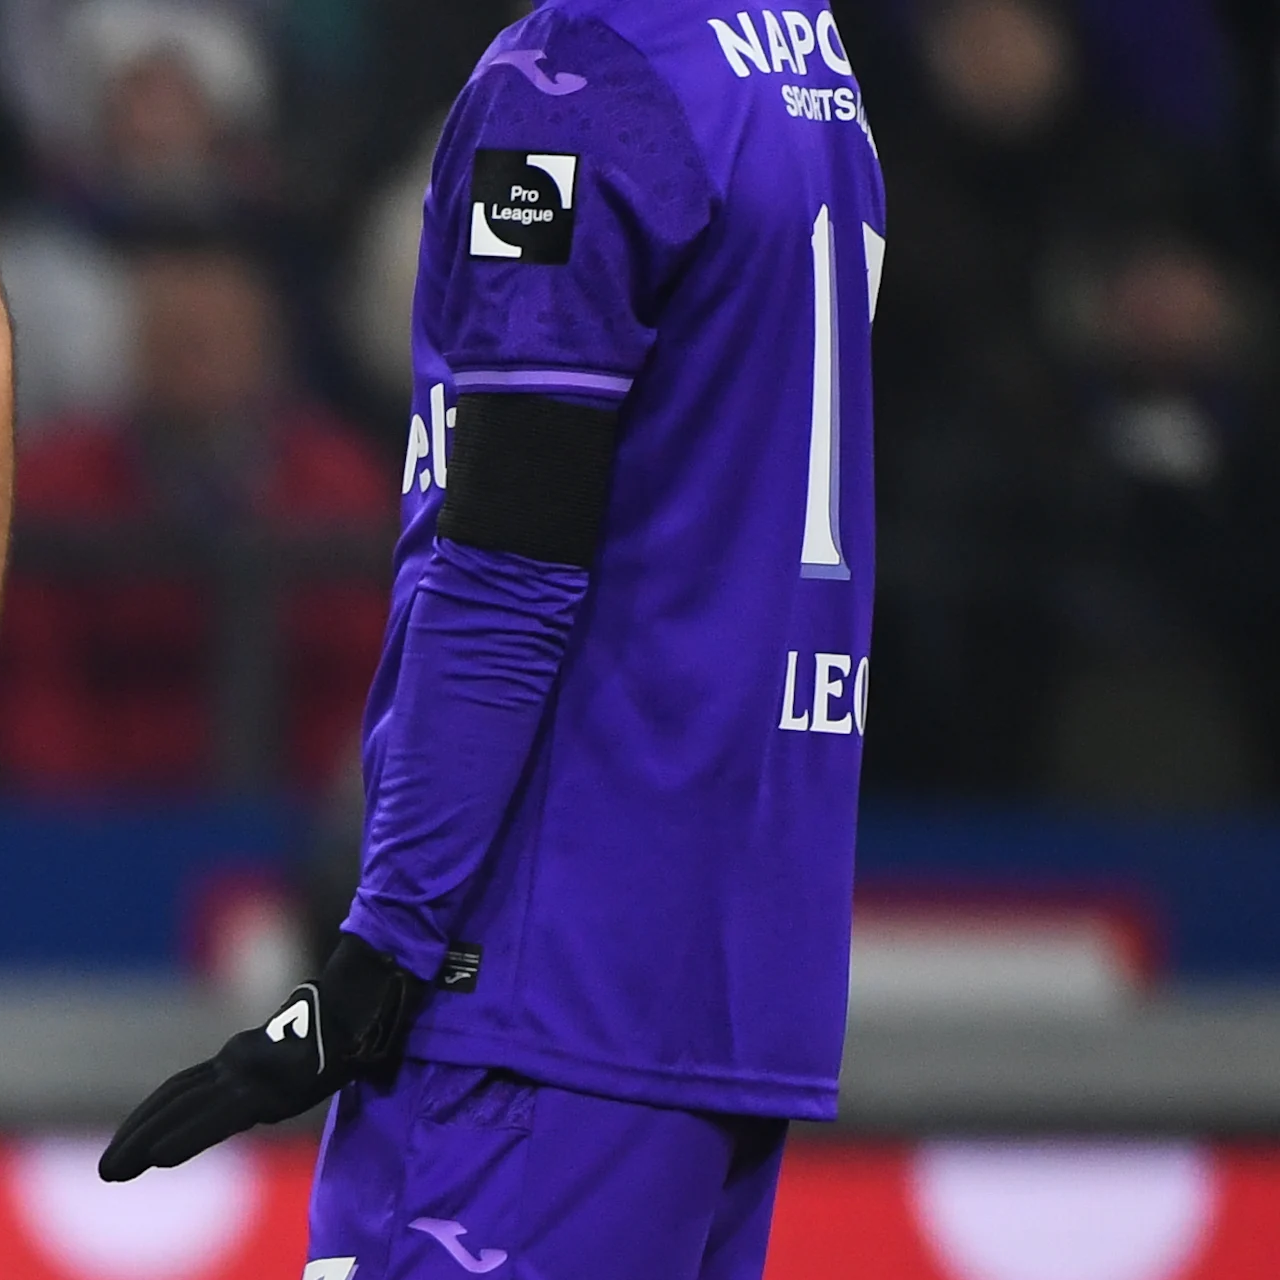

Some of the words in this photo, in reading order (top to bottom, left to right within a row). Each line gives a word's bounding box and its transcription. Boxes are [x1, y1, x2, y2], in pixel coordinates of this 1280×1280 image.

[781, 84, 856, 121] SPORTS
[510, 185, 540, 203] Pro
[491, 203, 554, 225] League
